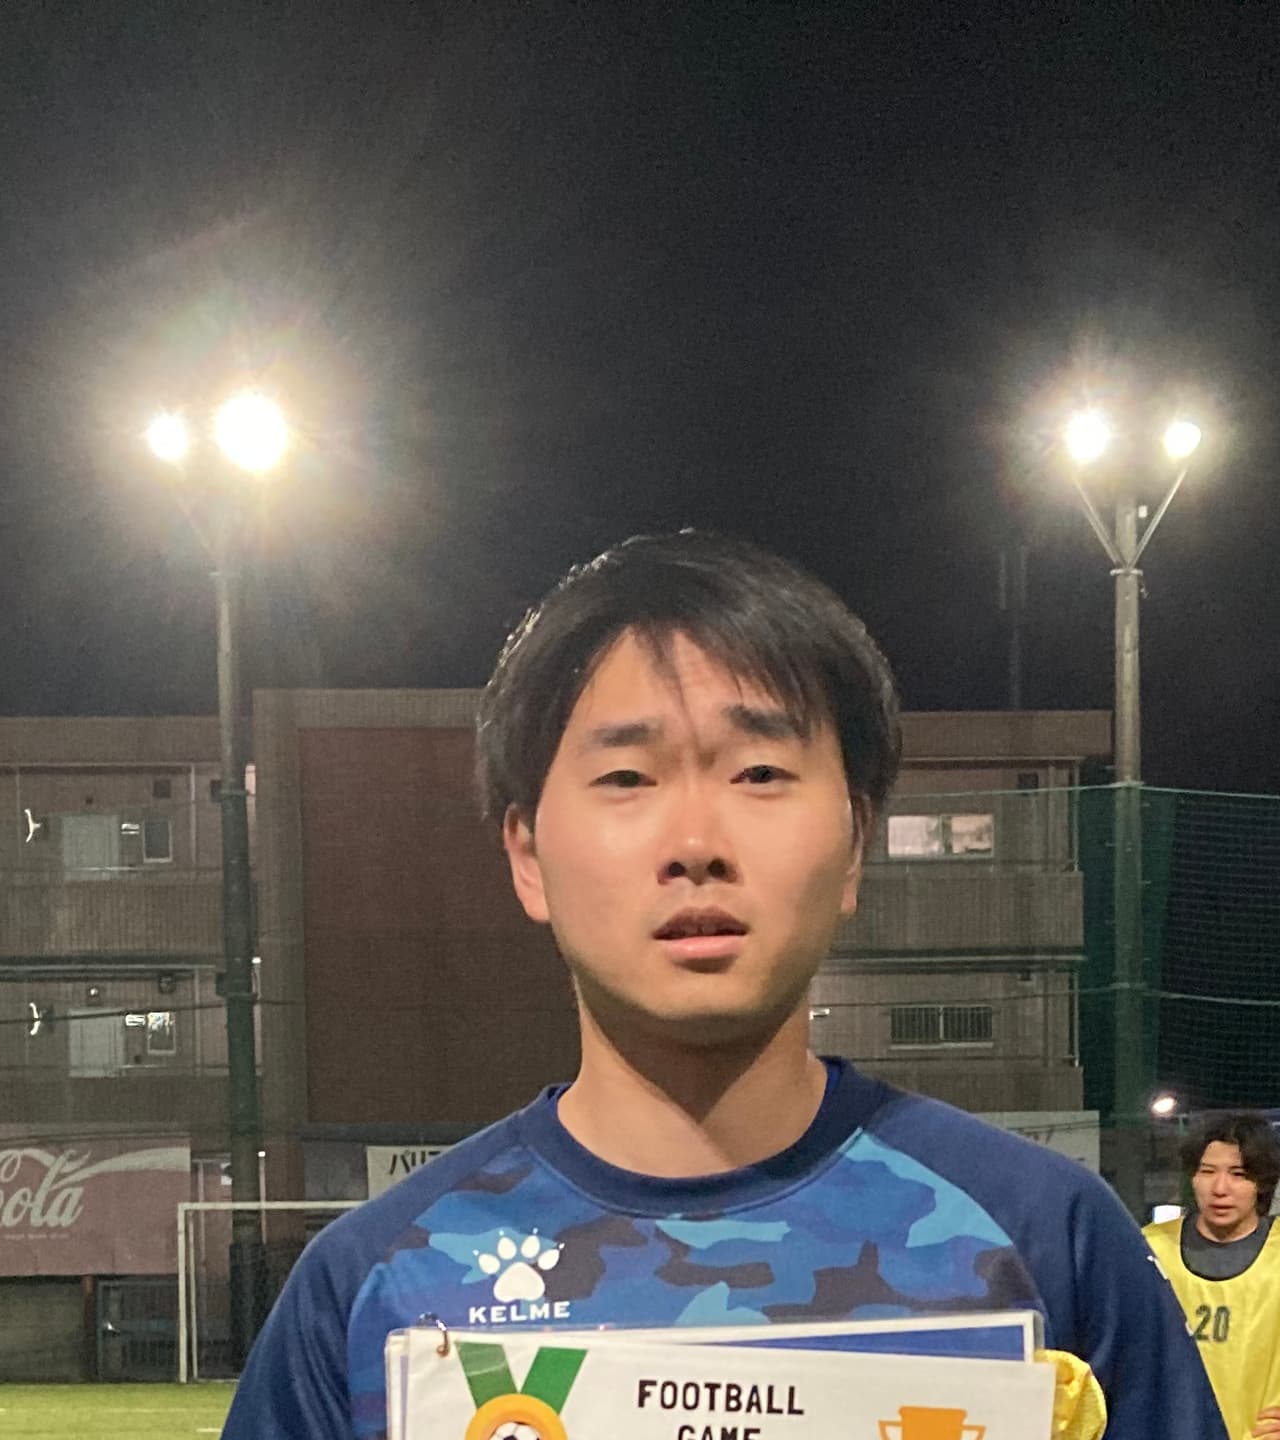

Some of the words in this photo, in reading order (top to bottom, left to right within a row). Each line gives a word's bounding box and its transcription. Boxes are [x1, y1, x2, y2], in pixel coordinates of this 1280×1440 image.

[468, 1301, 571, 1323] KELME
[1194, 1305, 1231, 1342] 20
[637, 1379, 805, 1416] FOOTBALL
